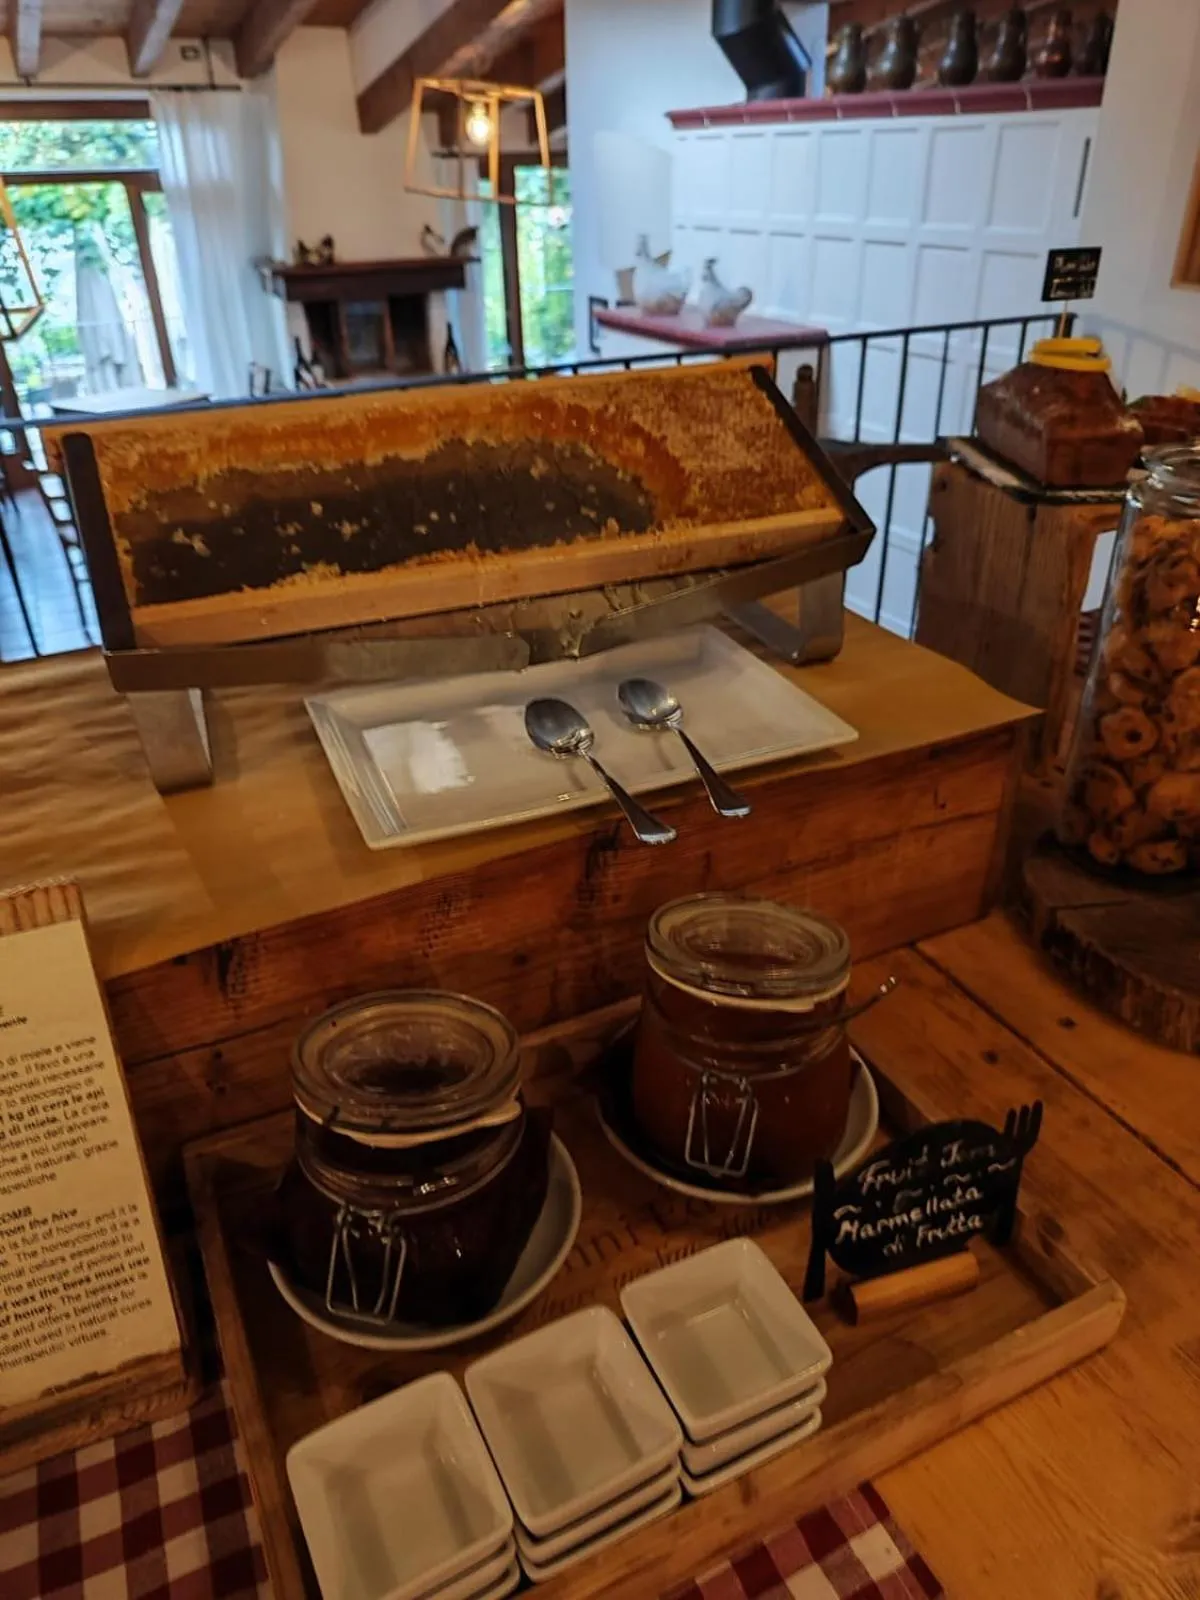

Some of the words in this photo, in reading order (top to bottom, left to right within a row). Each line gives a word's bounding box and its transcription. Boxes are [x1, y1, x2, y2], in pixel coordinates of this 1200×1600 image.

[8, 1112, 24, 1123] kg
[27, 1104, 39, 1117] di
[42, 1099, 69, 1113] cera
[71, 1094, 83, 1104] le
[86, 1086, 105, 1101] api
[9, 1124, 21, 1136] di
[63, 1109, 79, 1120] La
[31, 1145, 49, 1157] noi
[83, 1140, 119, 1158] grazie
[858, 1143, 929, 1196] Fruit
[8, 1240, 20, 1250] is
[42, 1228, 53, 1239] of
[56, 1218, 91, 1235] honey
[95, 1208, 117, 1225] and
[29, 1218, 48, 1230] the
[52, 1208, 77, 1222] hive
[835, 1185, 984, 1245] Marmellata
[883, 1231, 904, 1257] di
[916, 1211, 984, 1248] Frutta
[16, 1249, 38, 1262] The
[41, 1227, 108, 1256] honeycomb
[69, 1235, 119, 1261] essential
[121, 1232, 133, 1243] to
[4, 1283, 24, 1297] the
[26, 1268, 71, 1290] storage
[72, 1261, 84, 1274] of
[123, 1240, 145, 1257] and
[11, 1294, 36, 1309] wax
[39, 1287, 60, 1300] the
[62, 1275, 92, 1292] bees
[94, 1263, 126, 1280] must
[128, 1256, 151, 1269] use
[60, 1293, 81, 1306] The
[84, 1275, 135, 1299] beeswax
[12, 1321, 35, 1339] and
[37, 1311, 72, 1329] offers
[72, 1294, 118, 1317] benefits
[120, 1287, 136, 1300] for
[33, 1327, 63, 1346] used
[78, 1307, 118, 1331] natural
